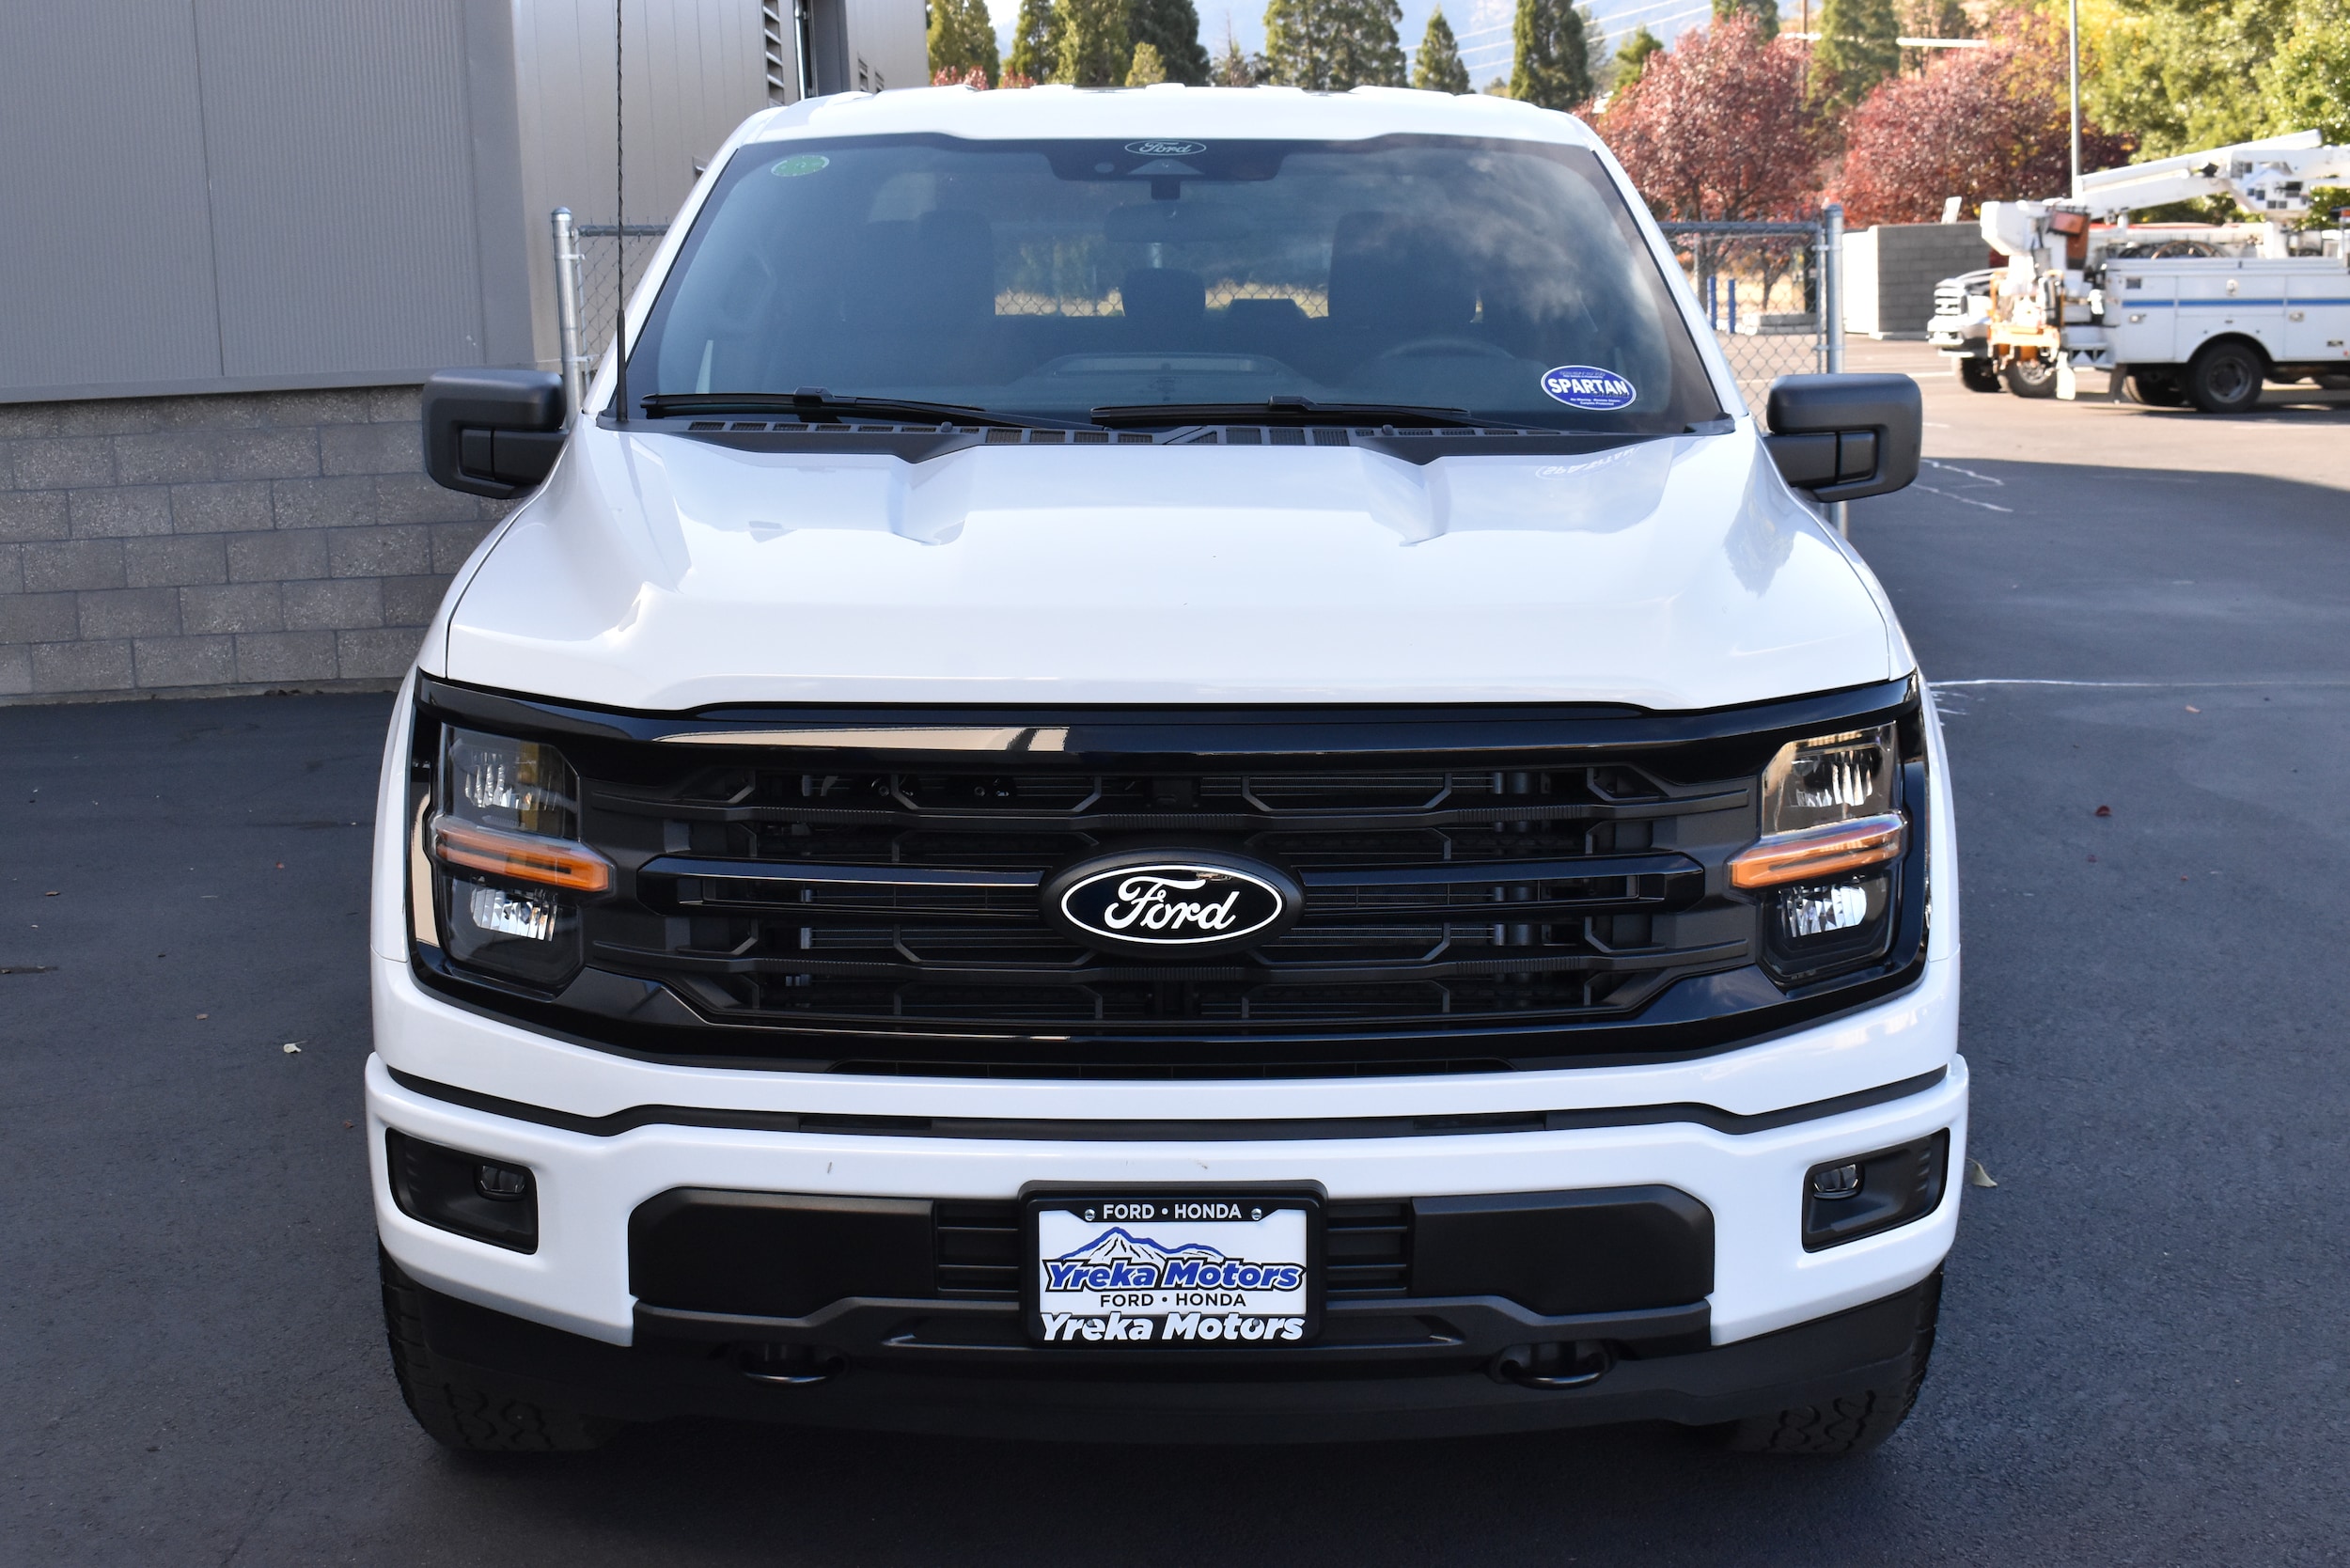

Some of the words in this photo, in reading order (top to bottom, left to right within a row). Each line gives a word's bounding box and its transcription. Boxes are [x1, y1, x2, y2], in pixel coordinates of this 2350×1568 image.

[1138, 142, 1193, 153] Ford
[1547, 378, 1630, 396] SPARTAN
[1104, 876, 1240, 930] Ford
[1103, 1204, 1154, 1219] FORD
[1175, 1204, 1242, 1219] HONDA
[1047, 1260, 1157, 1290] Yreka
[1163, 1259, 1304, 1290] Motors
[1100, 1294, 1154, 1308] FORD
[1175, 1293, 1246, 1308] HONDA
[1041, 1312, 1154, 1341] Yreka
[1162, 1312, 1305, 1341] Motors
